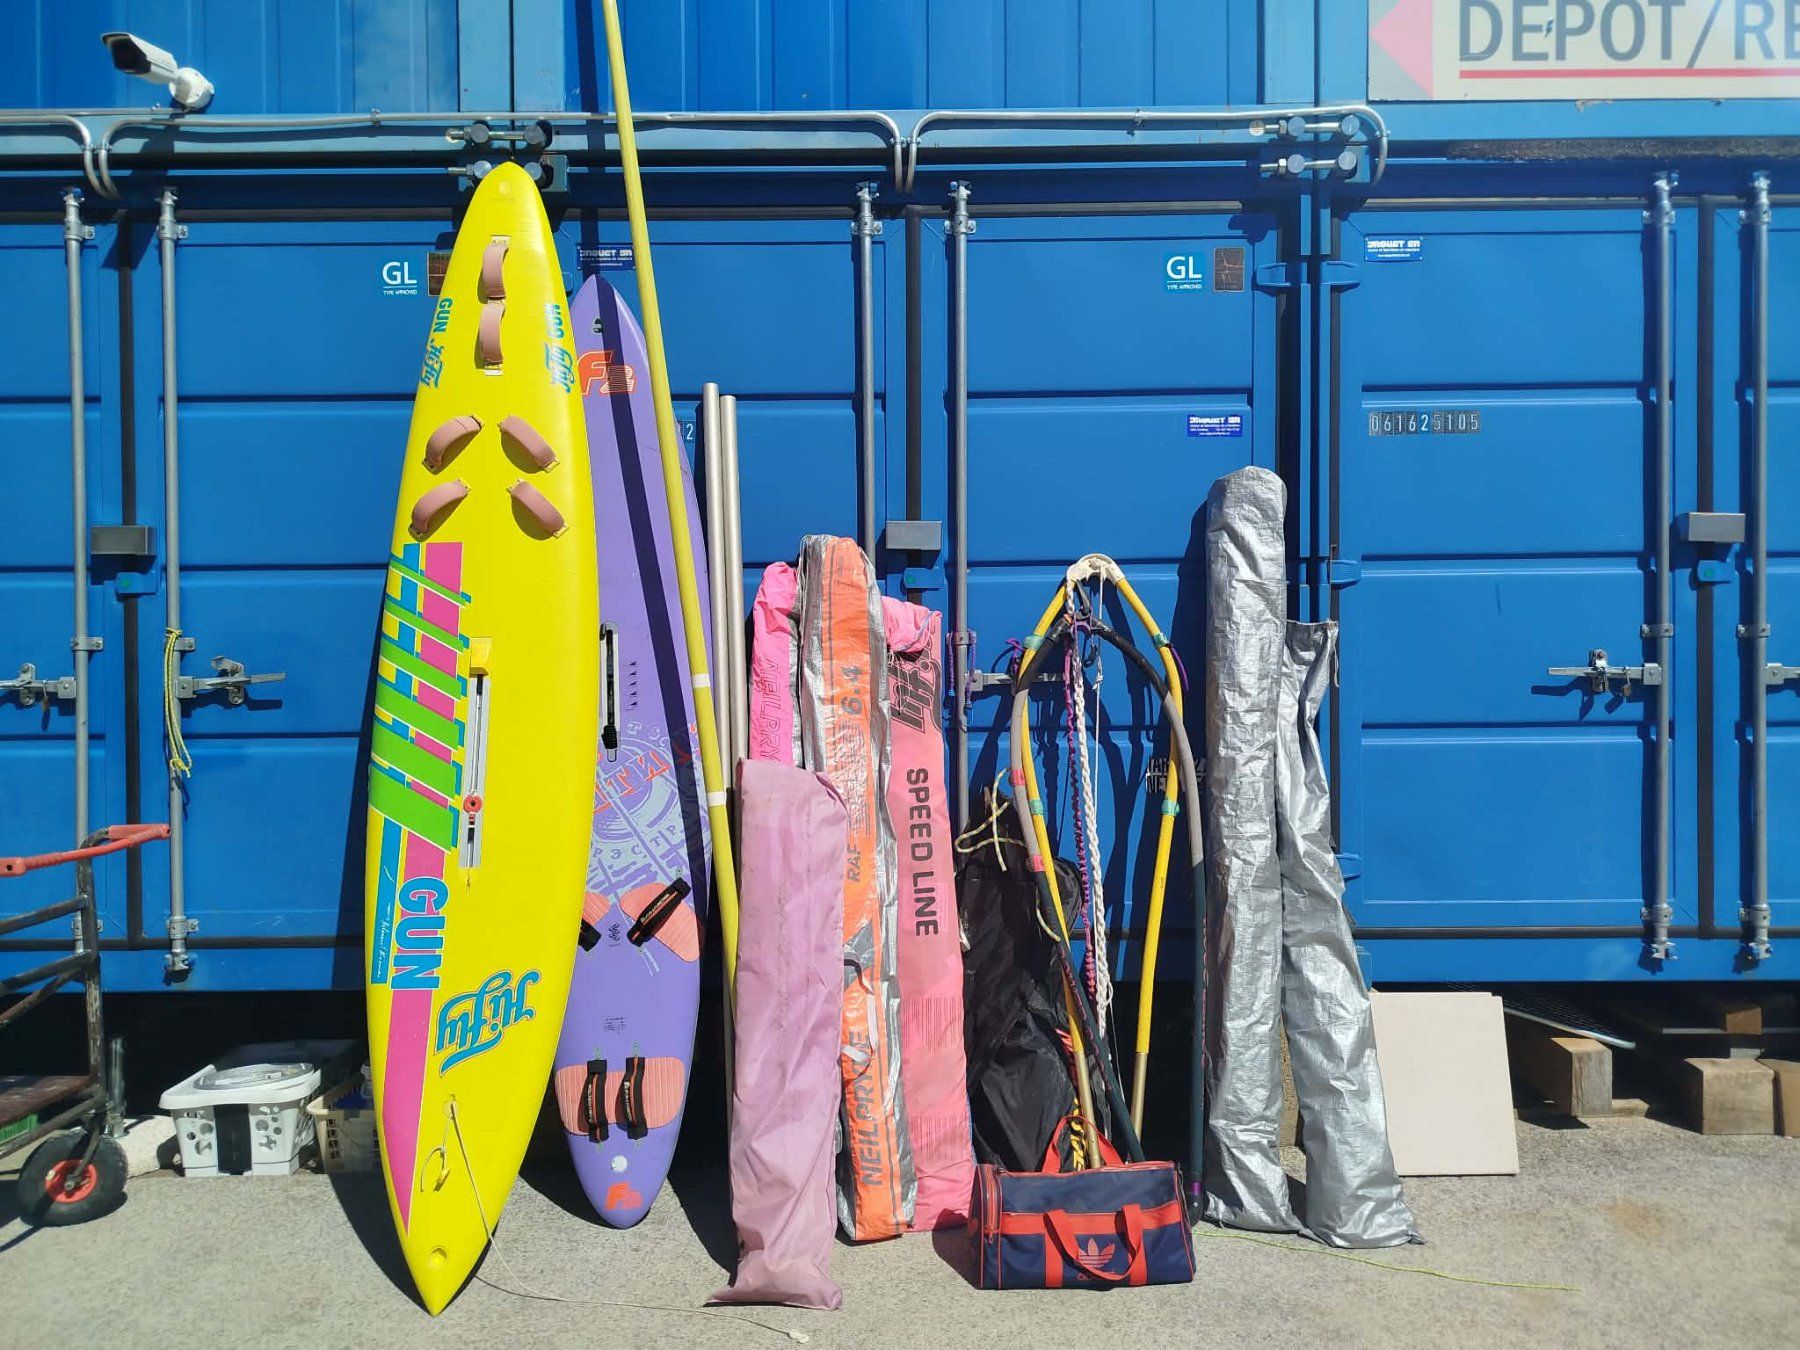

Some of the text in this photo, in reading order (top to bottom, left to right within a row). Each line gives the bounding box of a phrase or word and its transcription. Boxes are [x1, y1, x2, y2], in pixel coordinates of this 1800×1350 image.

[382, 261, 417, 285] GL
[1166, 256, 1202, 279] GL
[435, 297, 453, 333] GUN
[757, 658, 781, 762] NEILPRY
[906, 767, 939, 937] SPEED LINE
[390, 876, 450, 990] GUN
